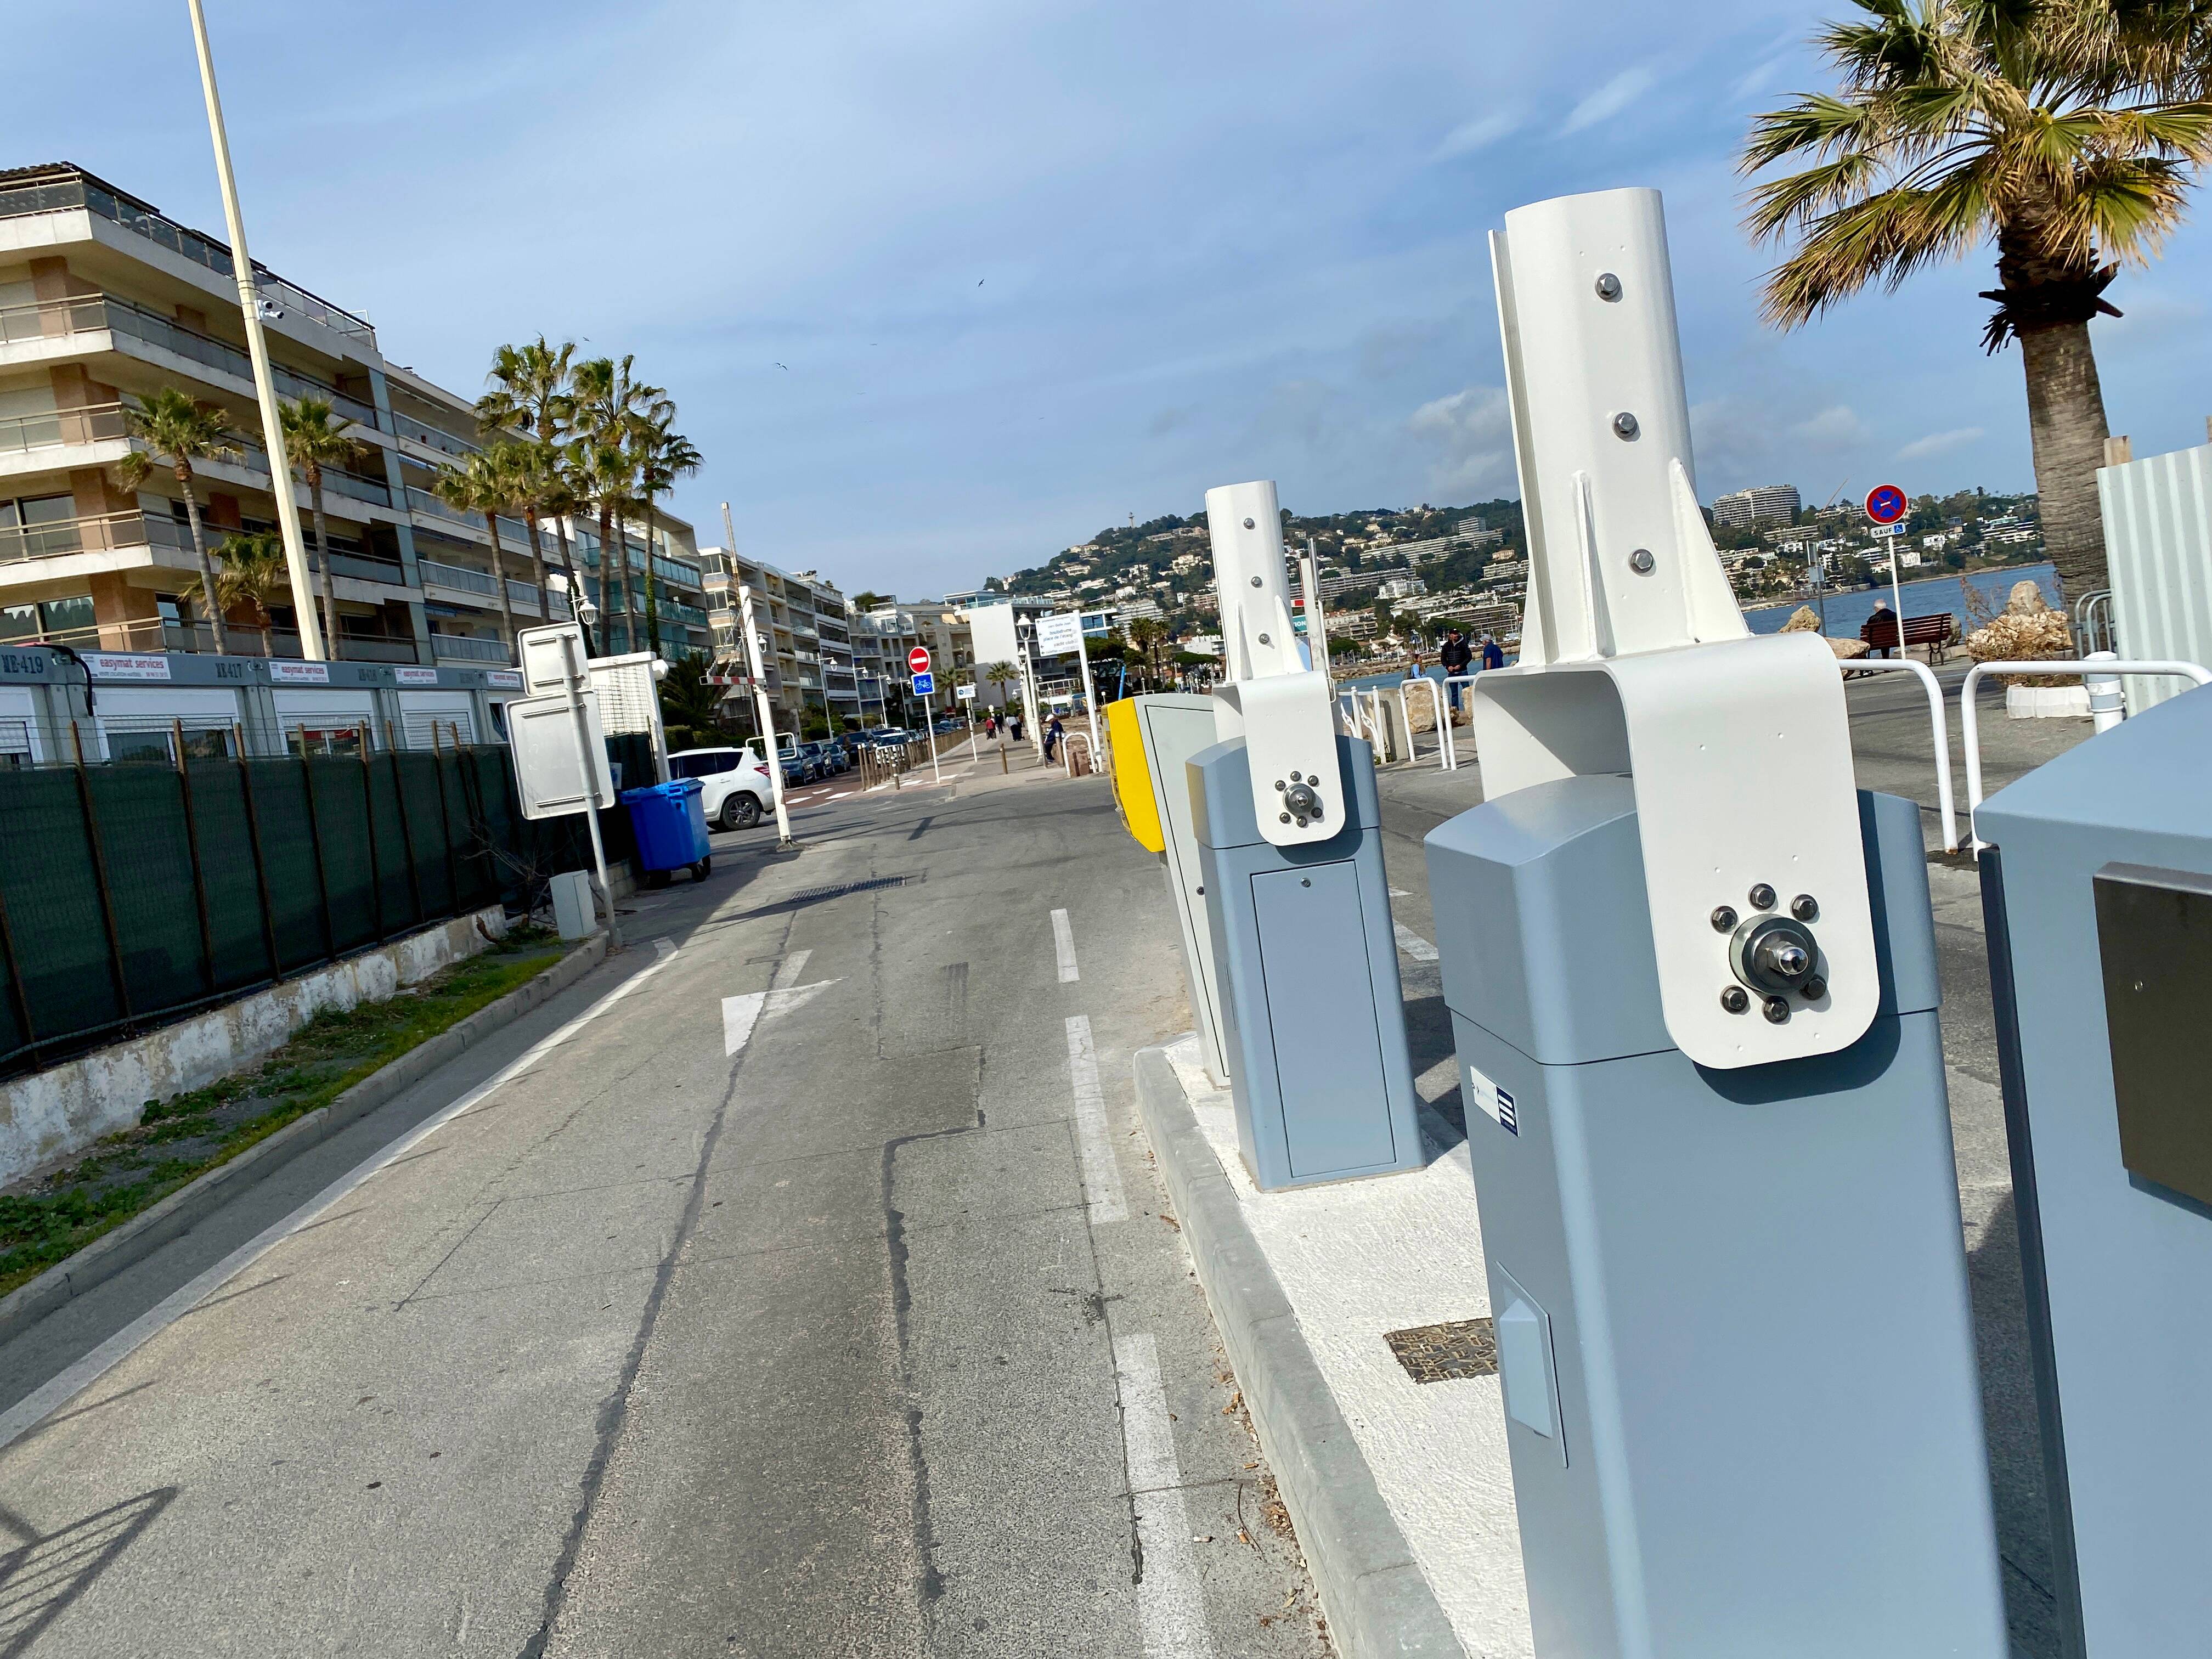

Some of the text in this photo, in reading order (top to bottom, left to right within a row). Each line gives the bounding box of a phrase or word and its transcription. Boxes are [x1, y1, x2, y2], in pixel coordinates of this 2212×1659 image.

[1874, 527, 1892, 535] SAUF
[100, 658, 133, 671] easymat
[135, 658, 164, 669] services
[281, 665, 303, 676] easymat
[305, 665, 325, 674] services
